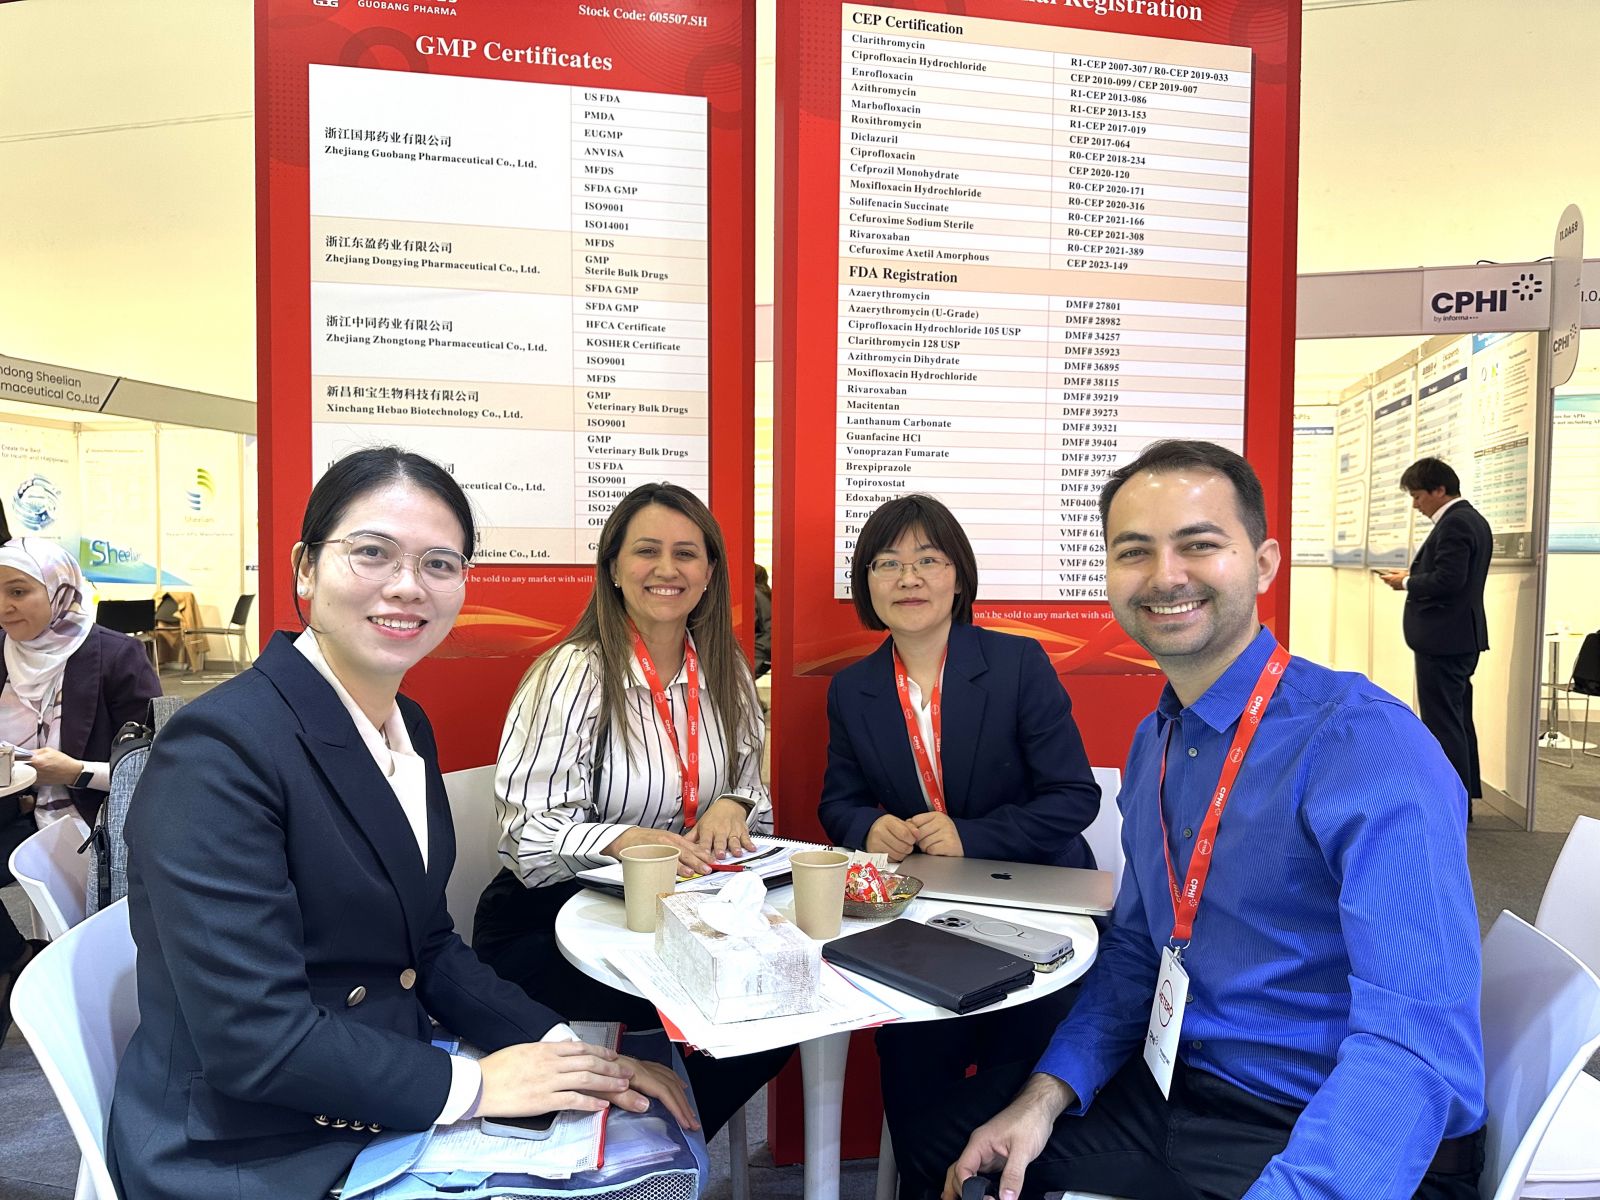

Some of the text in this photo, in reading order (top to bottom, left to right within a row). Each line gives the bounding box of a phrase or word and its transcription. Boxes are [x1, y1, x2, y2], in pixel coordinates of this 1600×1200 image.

[357, 0, 456, 15] GUOBANG PHARMA
[578, 4, 707, 26] Stock Code: 605507.SH
[852, 12, 963, 34] CEP Certification
[851, 34, 925, 49] Clarithromycin
[416, 35, 612, 70] GMP Certificates
[851, 50, 986, 71] Ciprofloxacin Hydrochloride
[852, 67, 913, 80] Enrofloxacin
[1071, 58, 1107, 69] R1-CEP
[1108, 62, 1147, 72] 2007-307
[1154, 66, 1189, 77] R0-CEP
[1190, 70, 1228, 81] 2019-033
[851, 83, 916, 96] Azithromycin
[1070, 73, 1090, 82] CEP
[1092, 75, 1131, 86] 2010-099
[1138, 80, 1158, 89] CEP
[1159, 82, 1197, 93] 2019-007
[584, 92, 620, 103] US FDA
[1070, 89, 1147, 103] R1-CEP 2013-086
[851, 100, 920, 113] Marbofloxacin
[584, 111, 614, 120] PMDA
[851, 115, 921, 129] Roxithromycin
[584, 129, 623, 139] EUGMP
[1070, 120, 1146, 134] R1-CEP 2017-019
[324, 127, 451, 146] 浙江国邦药业有限公司
[851, 132, 897, 143] Diclazuril
[324, 145, 537, 168] Zhejiang Guobang Pharmaceutical Co., Ltd.
[585, 147, 623, 157] ANVISA
[585, 165, 614, 174] MFDS
[850, 164, 959, 179] Cefprozil Monohydrate
[1068, 166, 1130, 178] CEP 2020-120
[584, 184, 637, 194] SFDA GMP
[850, 180, 981, 197] Moxifloxacin Hydrochloride
[585, 201, 623, 211] ISO9001
[849, 197, 949, 211] Solifenacin Succinate
[585, 220, 628, 230] ISO14001
[849, 213, 974, 229] Cefuroxime Sodium Sterile
[849, 229, 910, 241] Rivaroxaban
[325, 235, 451, 253] 浙江东盈药业有限公司
[325, 254, 540, 273] Zhejiang Dongying Pharmaceutical Co., Ltd.
[585, 255, 609, 264] GMP
[1066, 259, 1128, 269] CEP 2023-149
[585, 266, 668, 280] Sterile Bulk Drugs
[849, 265, 957, 282] FDA Registration
[848, 289, 929, 300] Azaerythromycin
[1431, 290, 1507, 313] CPHI
[848, 305, 978, 318] Azaerythromycin (U-Grade)
[1066, 300, 1120, 310] DMF# 27801
[326, 315, 452, 331] 浙江中同药业有限公司
[586, 320, 666, 332] HFCA Certificate
[326, 333, 547, 351] Zhejiang Zhongtong Pharmaceutical Co., Ltd.
[586, 338, 680, 350] KOSHER Certificate
[1553, 335, 1569, 352] CPHI
[587, 356, 624, 365] ISO9001
[847, 352, 959, 365] Azithromycin Dihydrate
[36, 371, 81, 387] Sheelian
[0, 382, 63, 399] maceutical
[326, 385, 478, 401] 新昌和宝生物科技有限公司
[586, 391, 611, 399] GMP
[327, 403, 523, 418] Xinchang Hebao Biotechnology Co., Ltd.
[587, 402, 688, 414] Veterinary Bulk Drugs
[847, 400, 899, 410] Macitentan
[847, 416, 951, 427] Lanthanum Carbonate
[846, 447, 949, 457] Vonoprazan Fumarate
[1061, 453, 1117, 462] DMF# 39737
[846, 462, 911, 472] Brexpiprazole
[470, 574, 481, 582] be
[511, 576, 526, 584] any
[1249, 696, 1263, 715] CPHI
[1215, 787, 1226, 807] CPHI
[1188, 879, 1199, 898] CPHI
